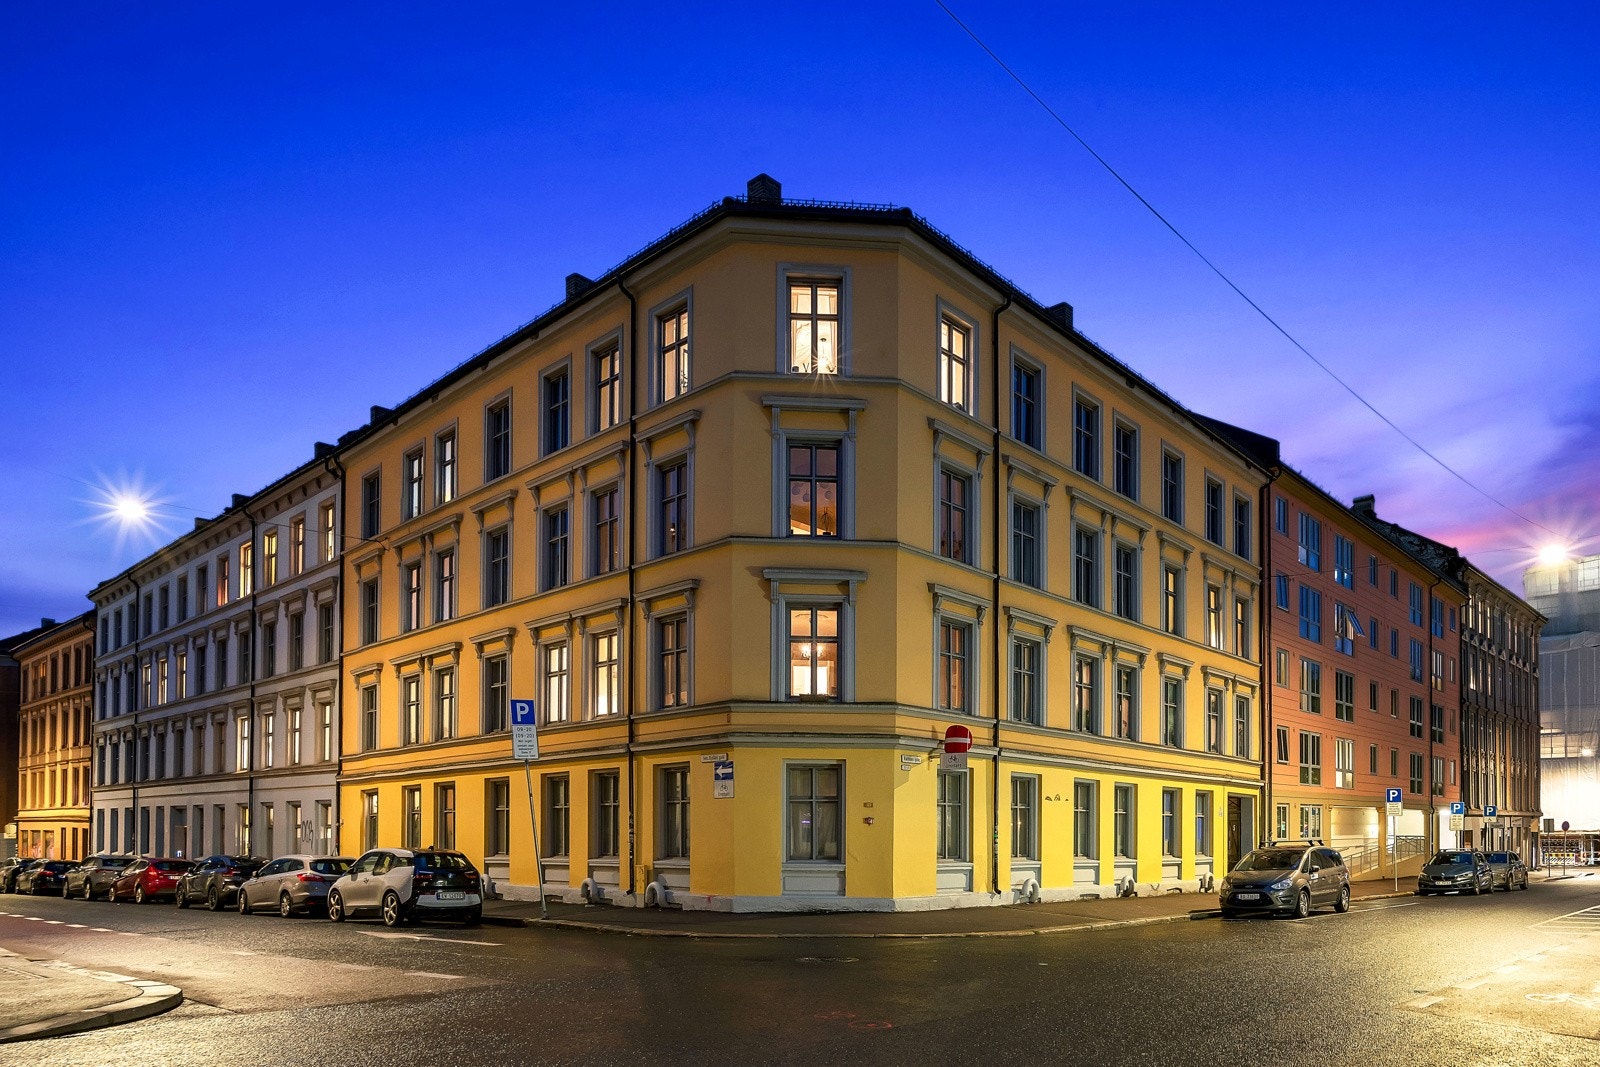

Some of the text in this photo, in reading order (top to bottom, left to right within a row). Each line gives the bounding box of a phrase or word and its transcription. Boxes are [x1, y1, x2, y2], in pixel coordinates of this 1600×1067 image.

[516, 702, 529, 722] P
[1389, 790, 1398, 801] P
[1453, 804, 1461, 813] P
[1486, 807, 1493, 816] P
